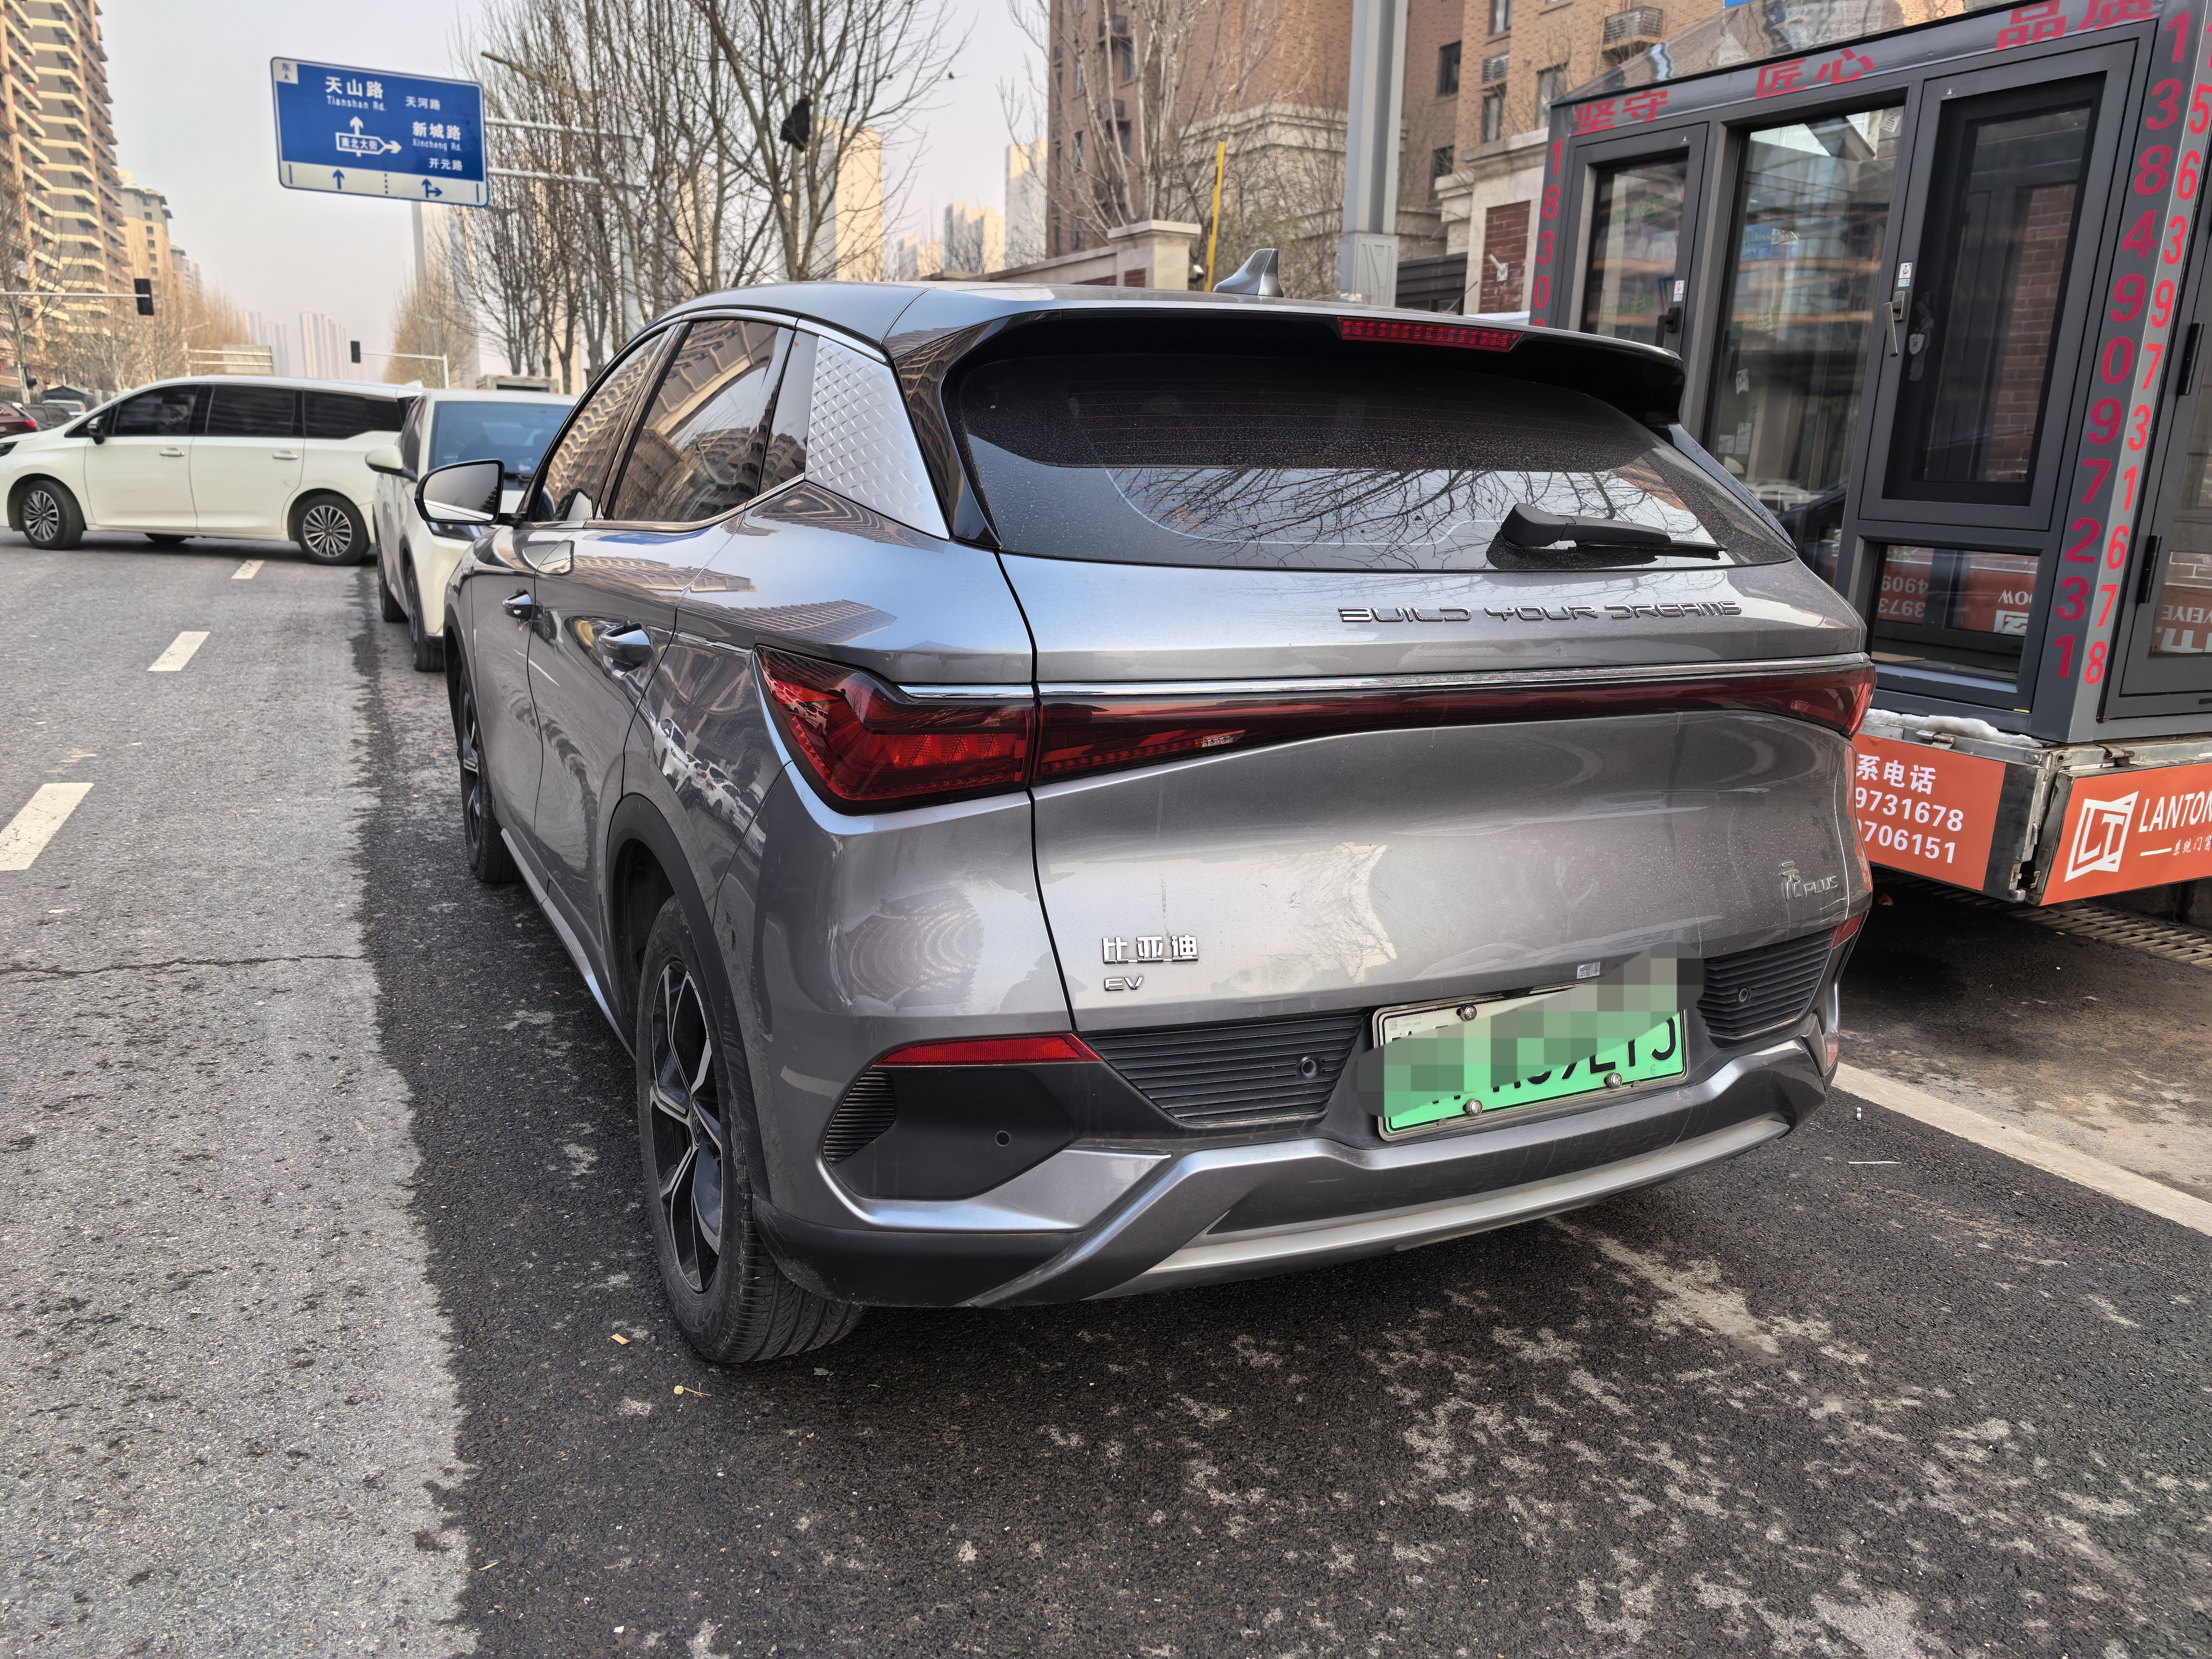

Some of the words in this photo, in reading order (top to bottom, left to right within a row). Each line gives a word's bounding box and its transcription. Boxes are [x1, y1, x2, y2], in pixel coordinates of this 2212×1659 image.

[325, 76, 383, 100] 天山路
[1573, 90, 1668, 136] 坚守
[1755, 48, 1877, 99] 匠心
[326, 95, 369, 110] Tianshan
[405, 96, 441, 111] 天河路
[412, 121, 461, 141] 新城路
[412, 138, 448, 152] Xincheng
[428, 157, 463, 171] 开元路
[1532, 138, 1563, 328] 1830
[2053, 11, 2190, 678] 13849097231
[2085, 23, 2212, 685] 5639731678
[1998, 589, 2033, 605] OW
[1338, 606, 1472, 623] BUILD
[1484, 605, 1599, 622] YOUR
[1604, 601, 1742, 619] DREAMS
[1856, 754, 1937, 795] 系电话
[1856, 787, 1964, 832] 9731678
[1102, 934, 1198, 965] 比亚迪
[1104, 976, 1143, 992] EV
